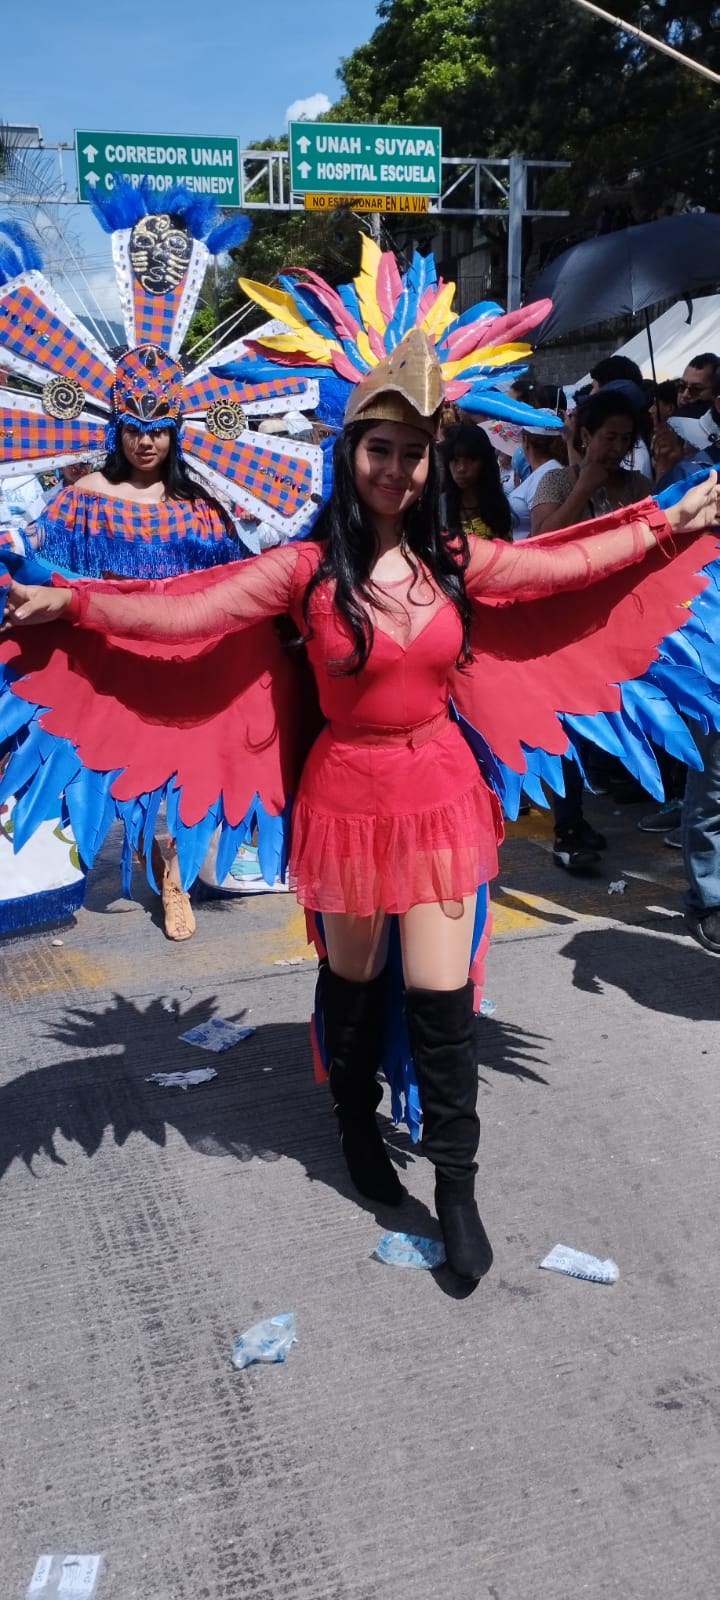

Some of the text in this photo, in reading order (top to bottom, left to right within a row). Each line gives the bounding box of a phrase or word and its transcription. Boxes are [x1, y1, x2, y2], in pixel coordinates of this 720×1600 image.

[104, 144, 233, 167] CORREDOR UNAH
[315, 135, 361, 154] UNAH
[375, 138, 436, 157] SUYAPA
[104, 172, 235, 194] CRRDOR KENNEDY
[317, 162, 436, 183] HOSPITAL ESCUELA
[312, 197, 325, 207] NO
[385, 196, 397, 211] EN
[399, 196, 410, 211] LA
[411, 196, 427, 212] VIA
